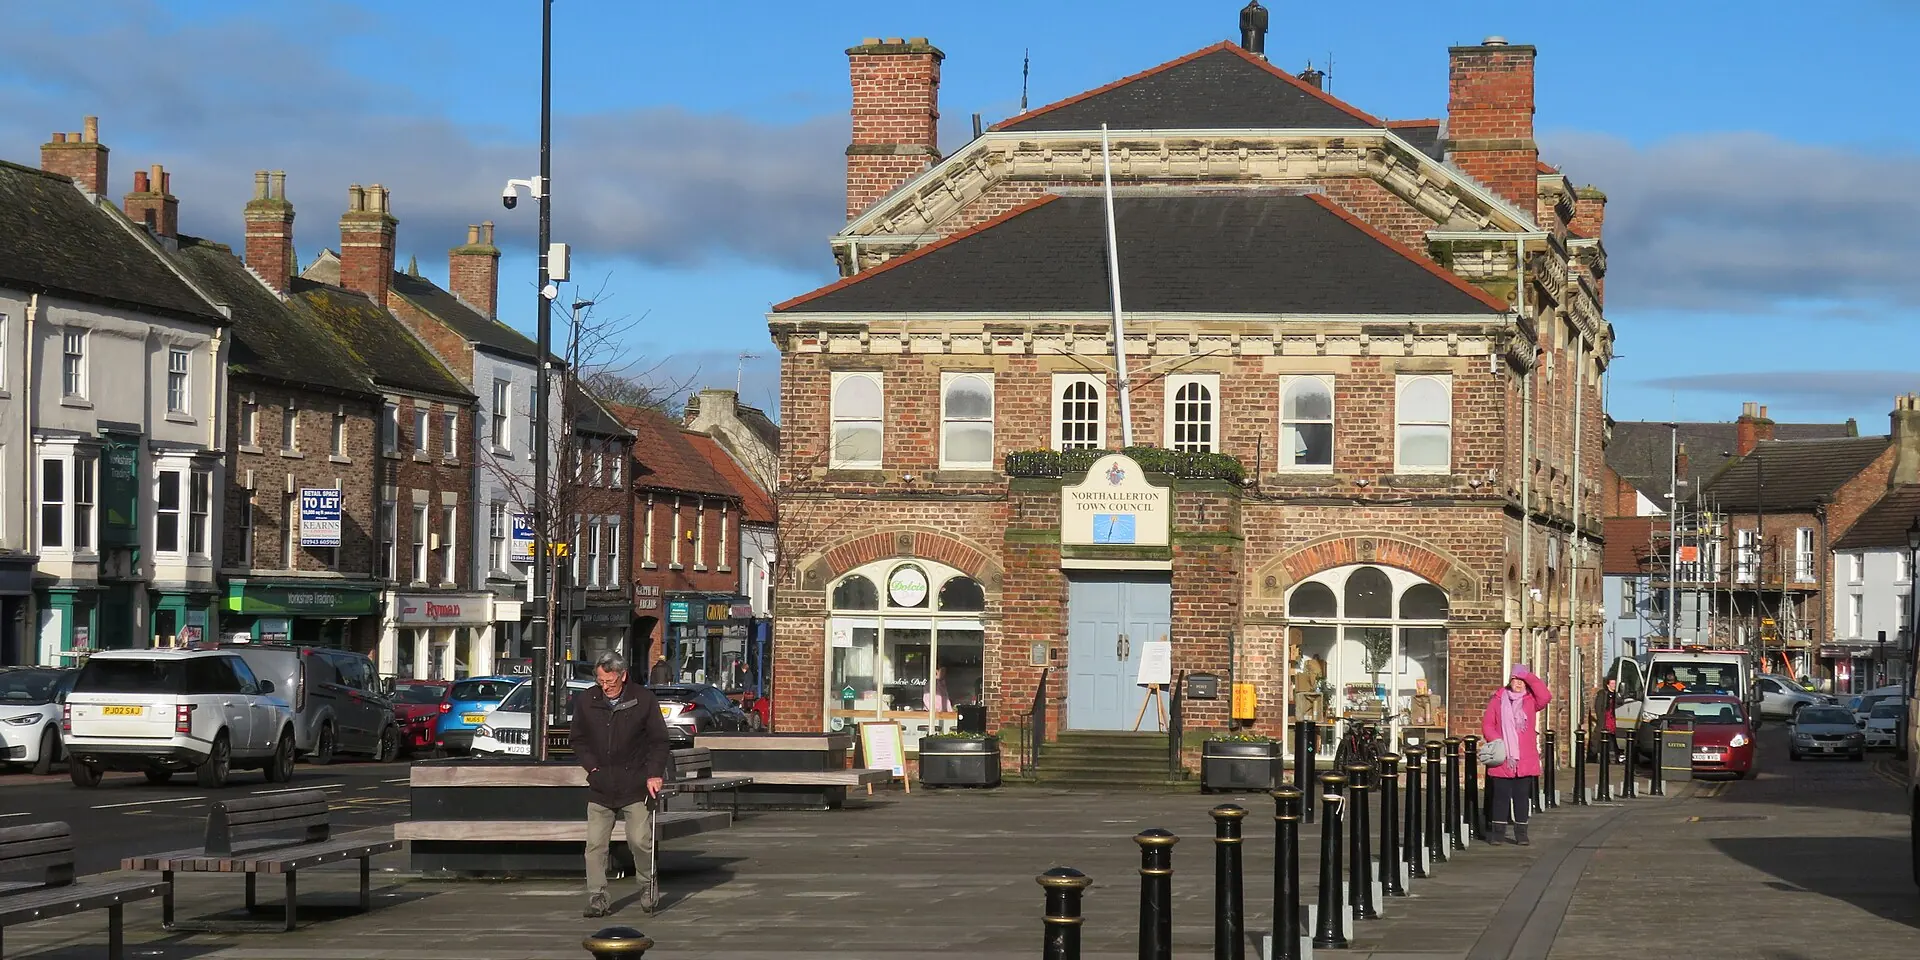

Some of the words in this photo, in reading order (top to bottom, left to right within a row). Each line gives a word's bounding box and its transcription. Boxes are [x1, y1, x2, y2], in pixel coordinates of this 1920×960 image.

[1071, 492, 1160, 501] NORTHALLERTON
[303, 498, 317, 508] TO
[320, 498, 339, 508] LET
[1076, 502, 1106, 511] TOWN
[1108, 503, 1154, 512] COUNCIL
[304, 521, 339, 529] KEARNS
[891, 580, 925, 592] Dolcie
[287, 592, 313, 604] Yorkshire
[313, 592, 335, 607] Trading
[425, 601, 461, 621] Ryman
[910, 678, 928, 686] Deli
[105, 706, 124, 715] PJ02
[125, 707, 140, 715] SAJ
